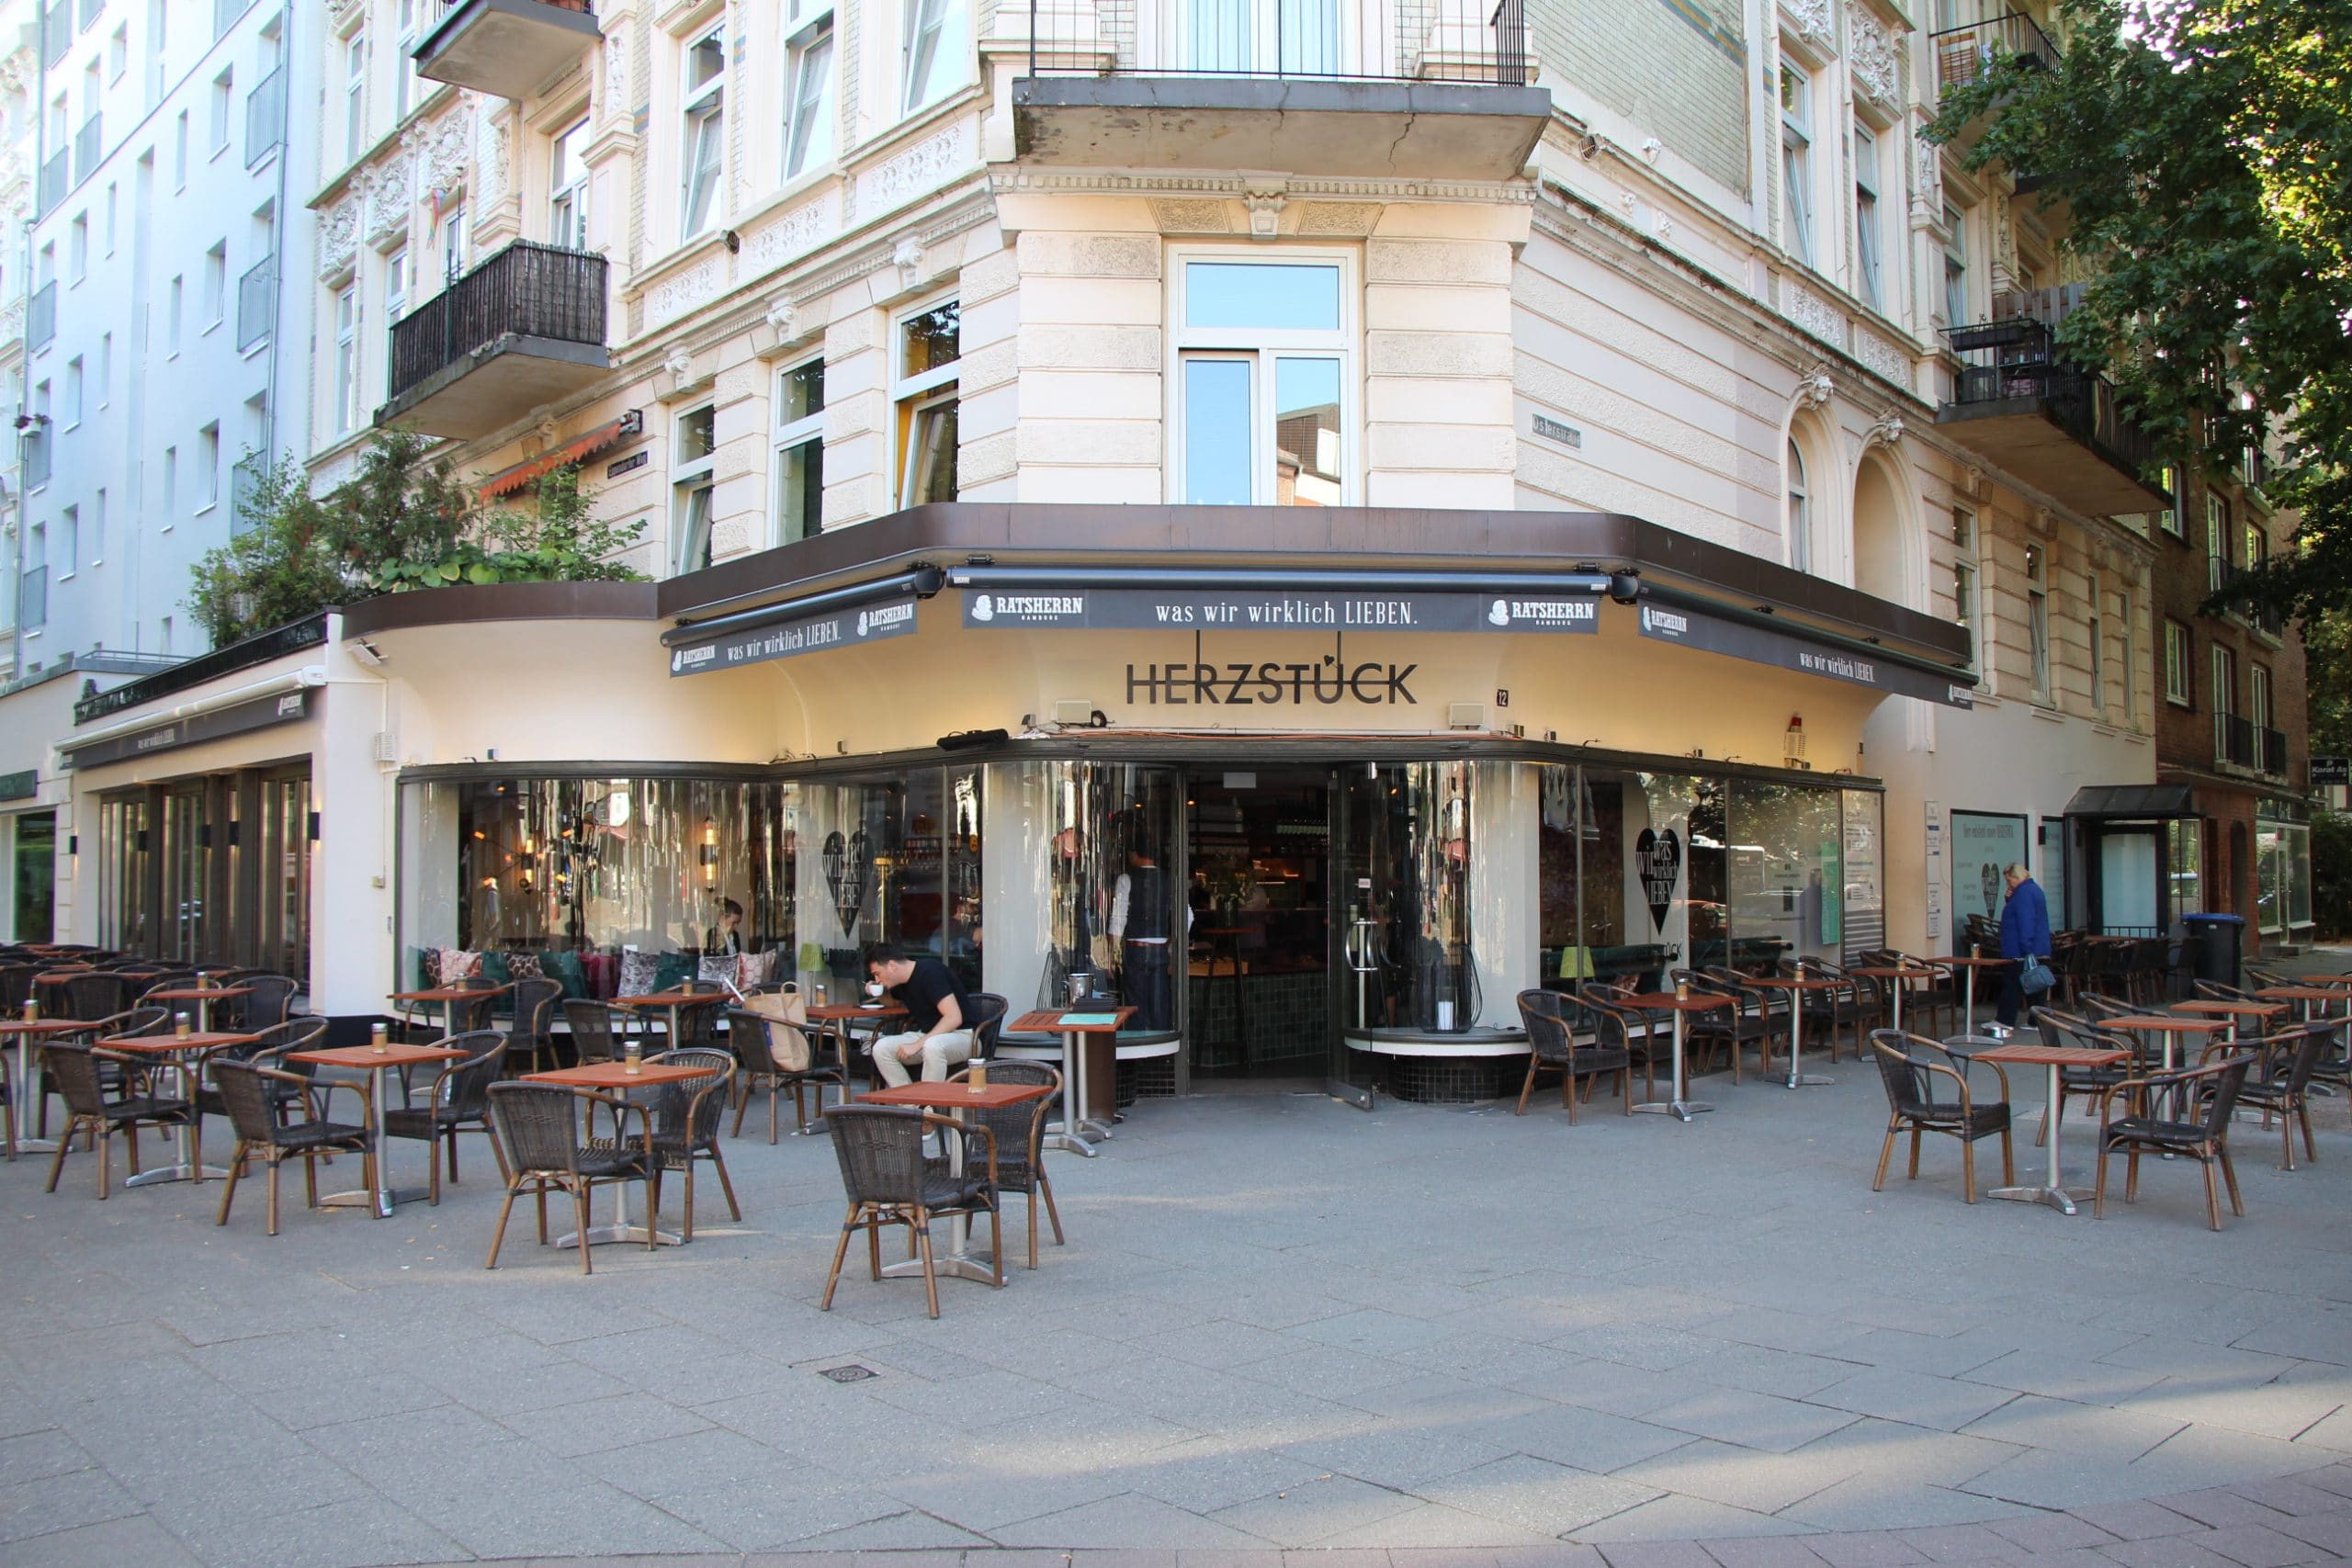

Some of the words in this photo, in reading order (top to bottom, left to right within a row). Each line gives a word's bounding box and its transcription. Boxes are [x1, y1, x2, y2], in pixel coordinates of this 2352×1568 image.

[869, 603, 913, 627] RATSHERRN
[997, 597, 1083, 614] RATSHERRN
[1156, 605, 1193, 623] was
[1204, 602, 1238, 623] wir
[1248, 600, 1335, 624] wirklich
[1345, 601, 1418, 625] LIEBEN.
[1511, 602, 1594, 619] RATSHERRN
[727, 645, 743, 661] was
[746, 639, 762, 658] wir
[764, 627, 803, 654] wirklich
[807, 620, 842, 647] LIEBEN.
[1126, 655, 1419, 705] HERZSTÜCK
[1498, 691, 1508, 706] 12
